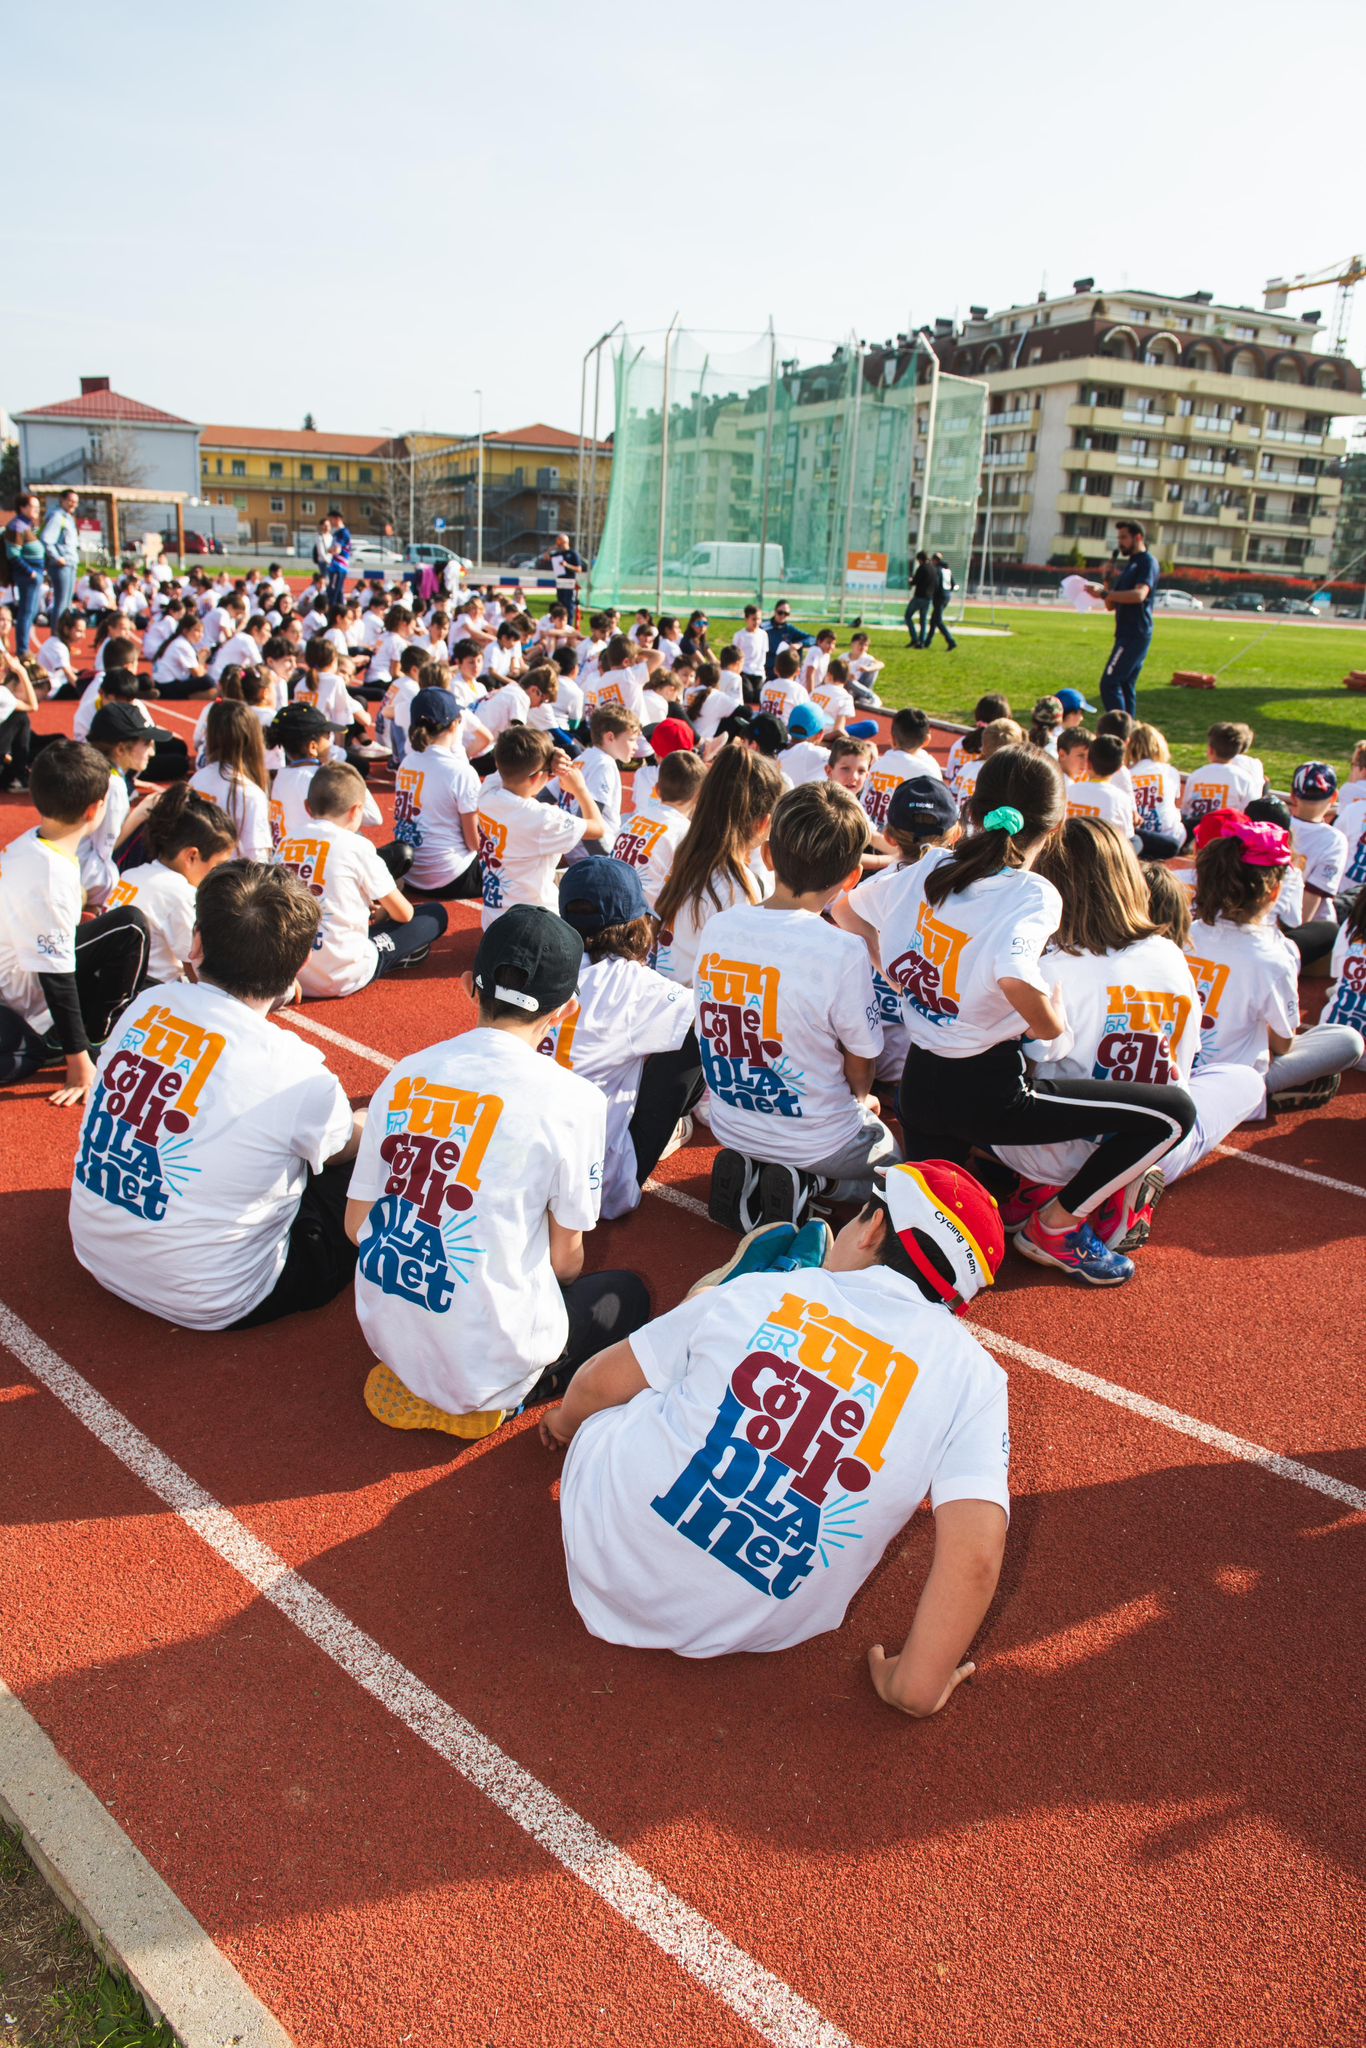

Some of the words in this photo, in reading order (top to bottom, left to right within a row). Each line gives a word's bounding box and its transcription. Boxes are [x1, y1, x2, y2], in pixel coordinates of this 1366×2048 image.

[698, 952, 783, 1042] run
[747, 995, 762, 1009] A
[1106, 984, 1192, 1062] run
[1163, 1021, 1173, 1034] A
[103, 1050, 190, 1147] cooler
[133, 1005, 227, 1118] run
[175, 1059, 192, 1075] A
[389, 1076, 505, 1193] run
[450, 1126, 467, 1143] A
[934, 1210, 965, 1243] Cycling
[965, 1245, 977, 1275] Team
[745, 1321, 800, 1359] FOR
[852, 1383, 877, 1408] A
[766, 1292, 920, 1472] run
[730, 1350, 872, 1506] cooler
